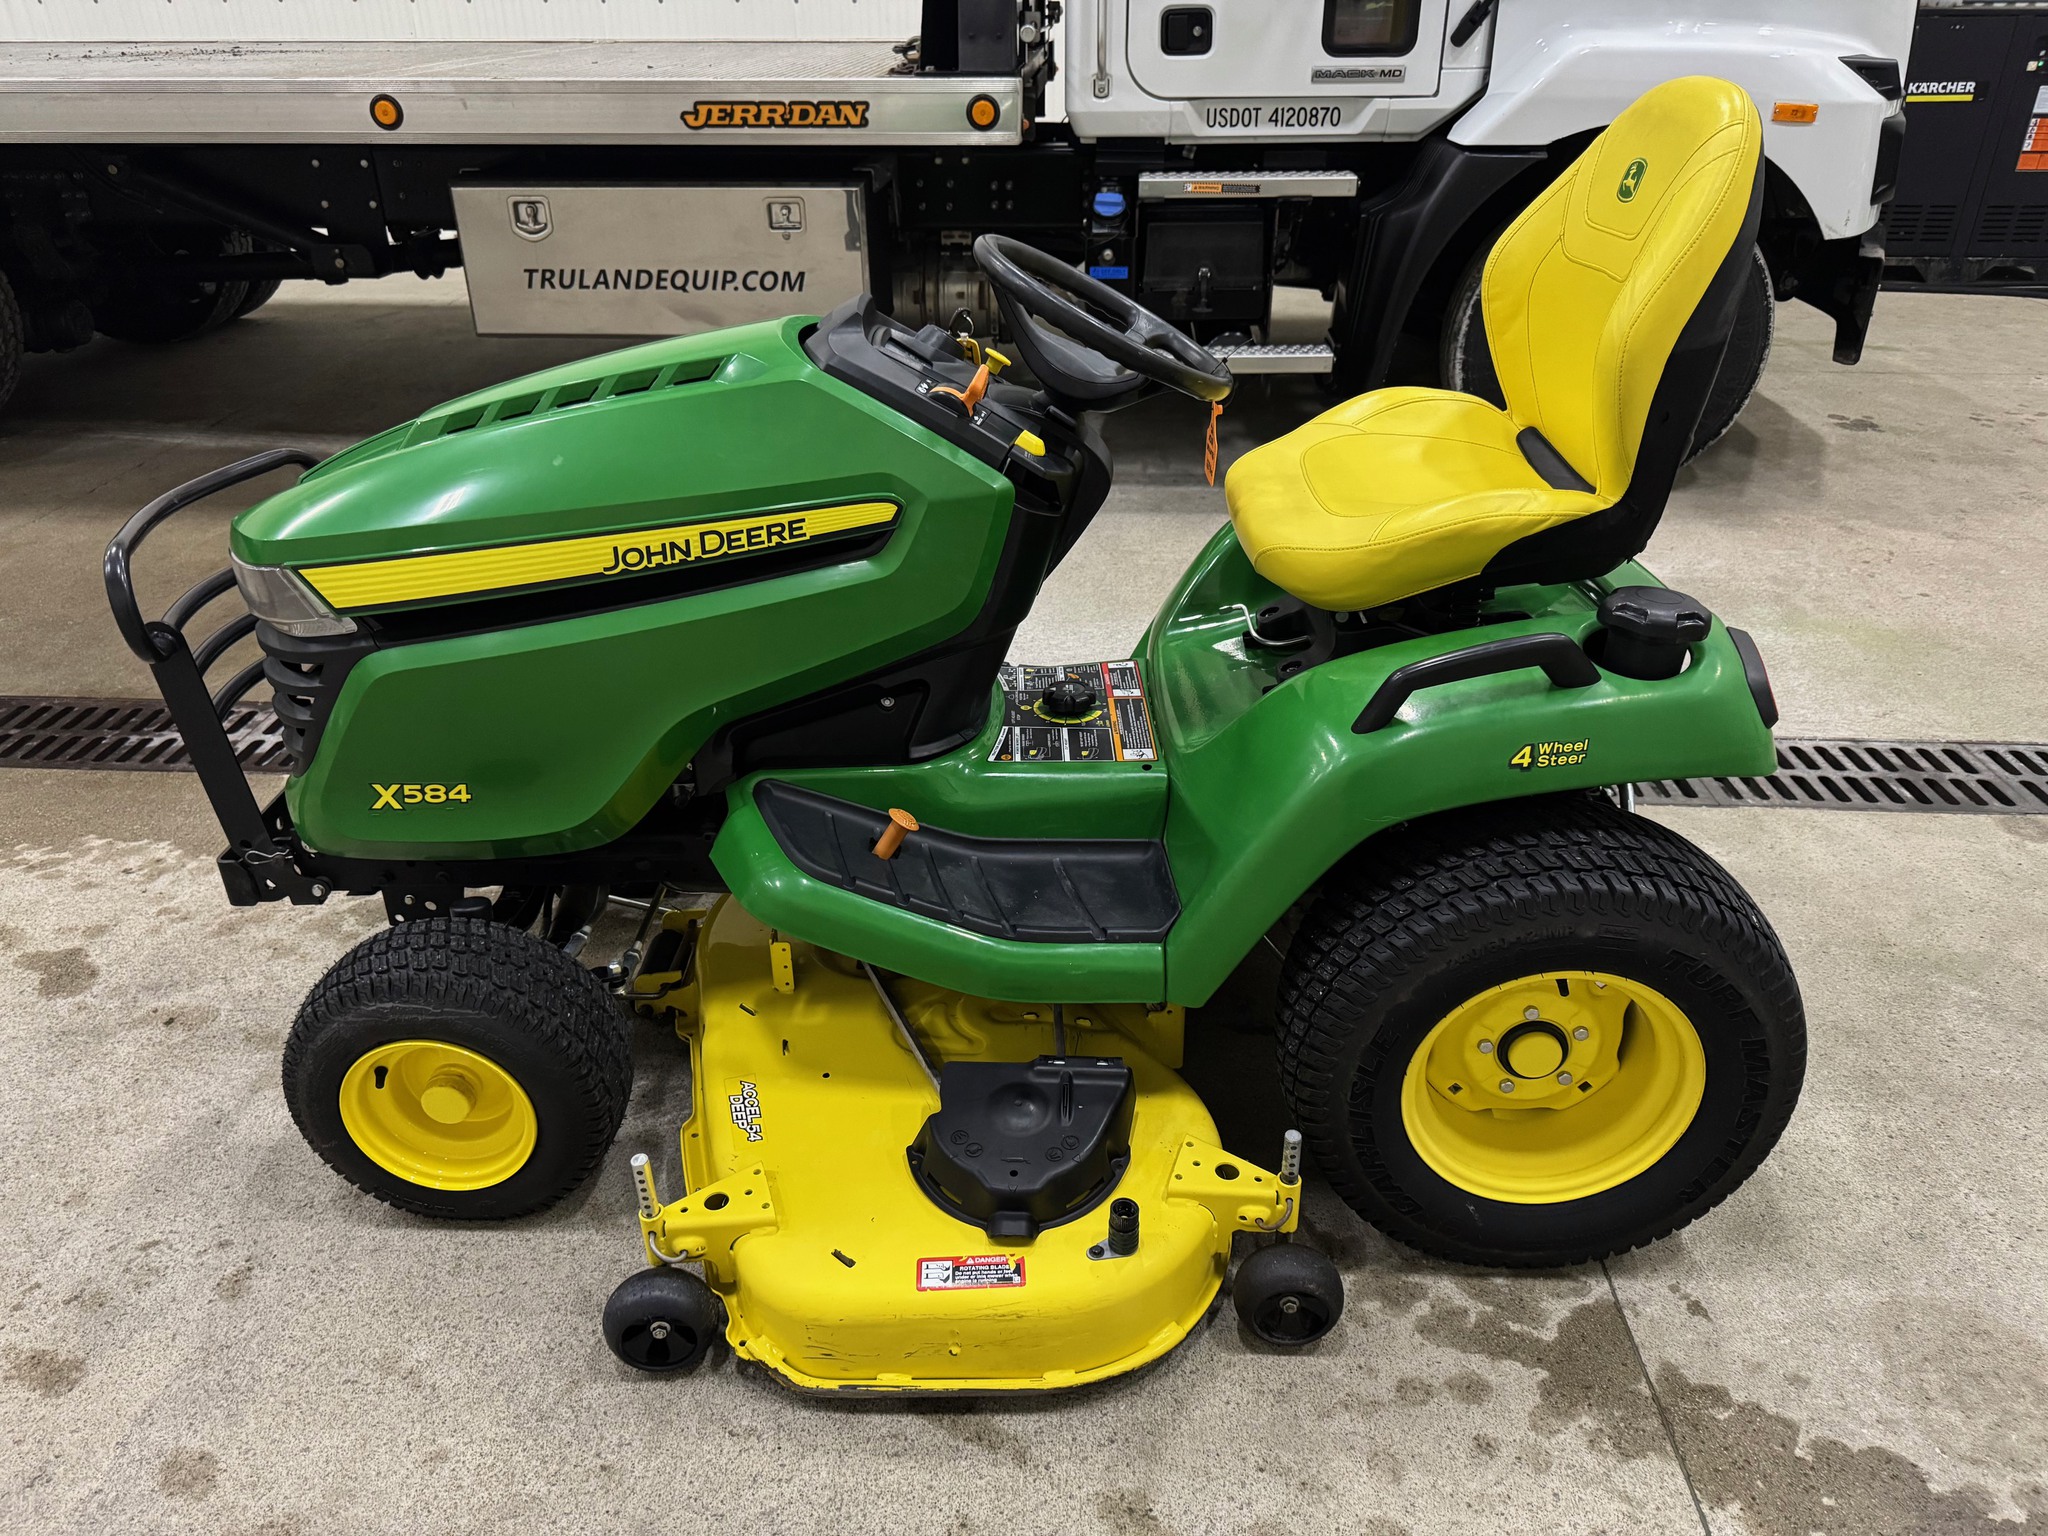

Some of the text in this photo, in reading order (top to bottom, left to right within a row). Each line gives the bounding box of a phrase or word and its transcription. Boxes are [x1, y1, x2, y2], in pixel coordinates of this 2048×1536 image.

[1379, 69, 1402, 78] MD
[1908, 81, 1976, 94] KÄRCHER
[1206, 107, 1341, 128] USDOT 4120870
[523, 268, 806, 293] TRULANDEQUIP.COM
[603, 518, 807, 572] JOHN DEERE
[1510, 738, 1589, 768] 4 Wheel
[1537, 753, 1586, 767] Steer
[369, 783, 472, 811] X584
[728, 1094, 748, 1129] DEEP
[740, 1080, 763, 1142] ACCEL 54
